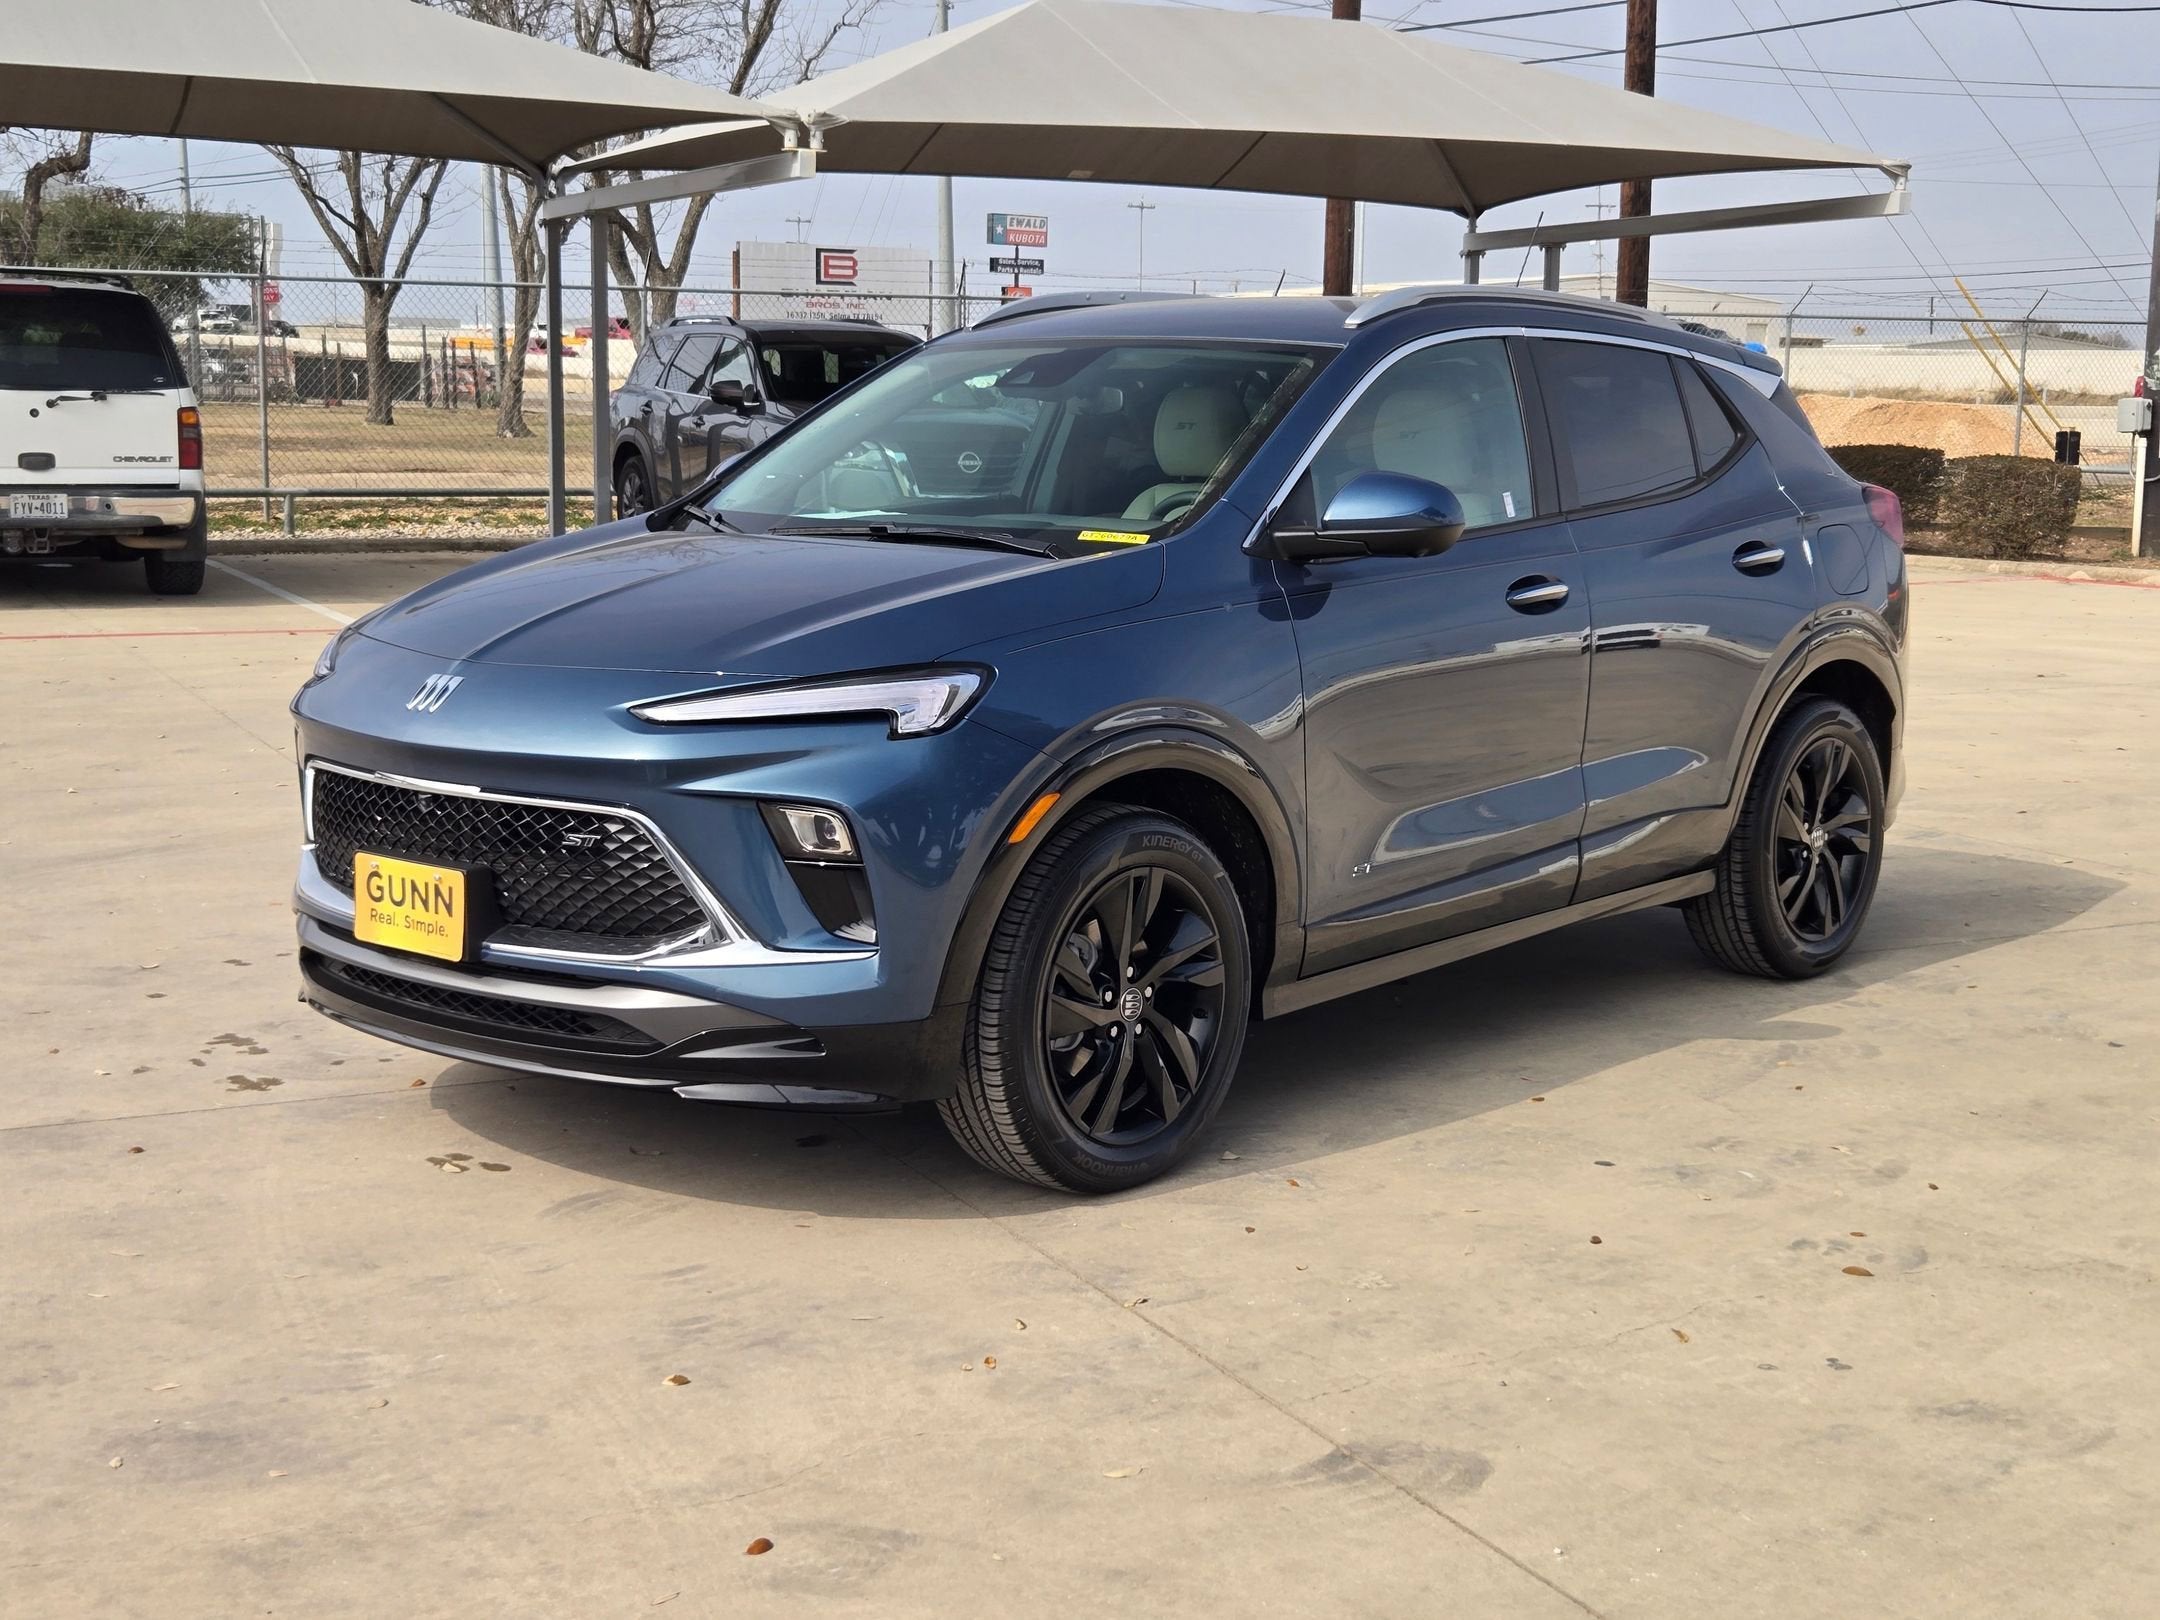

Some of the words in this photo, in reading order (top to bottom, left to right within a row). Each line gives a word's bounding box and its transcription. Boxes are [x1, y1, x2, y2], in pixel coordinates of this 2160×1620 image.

[1009, 217, 1046, 230] EWALD
[1009, 233, 1045, 244] KUBOTA
[562, 833, 602, 848] ST
[366, 870, 453, 918] GUNN
[370, 908, 400, 927] Real.
[404, 915, 449, 938] Simple.
